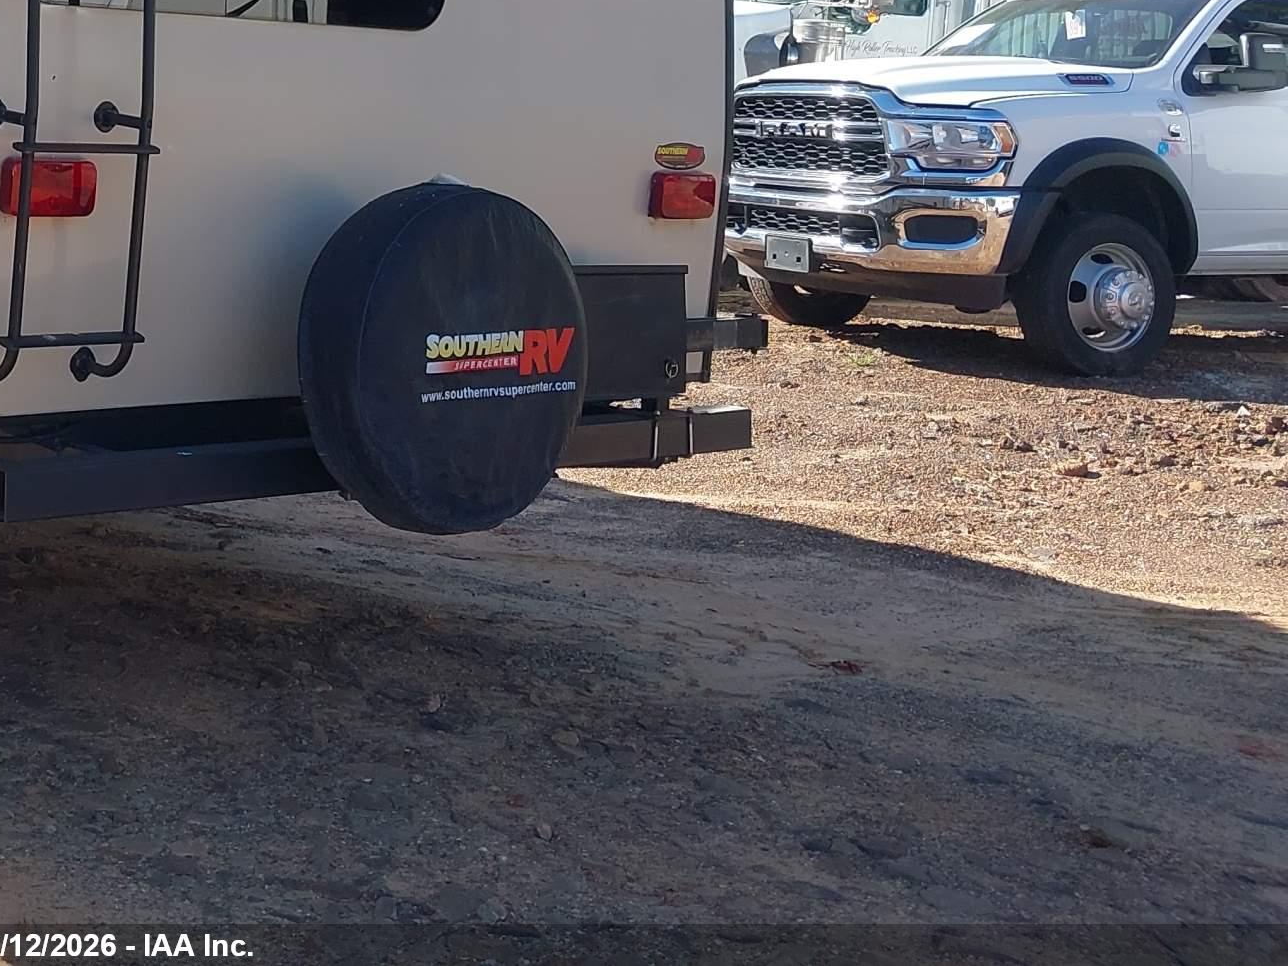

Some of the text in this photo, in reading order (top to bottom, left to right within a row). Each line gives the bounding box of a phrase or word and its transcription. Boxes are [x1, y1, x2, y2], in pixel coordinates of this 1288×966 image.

[756, 119, 834, 139] RAM
[426, 327, 575, 376] SOUTHERN RV
[421, 380, 576, 403] www.southernrvsupercenter.com
